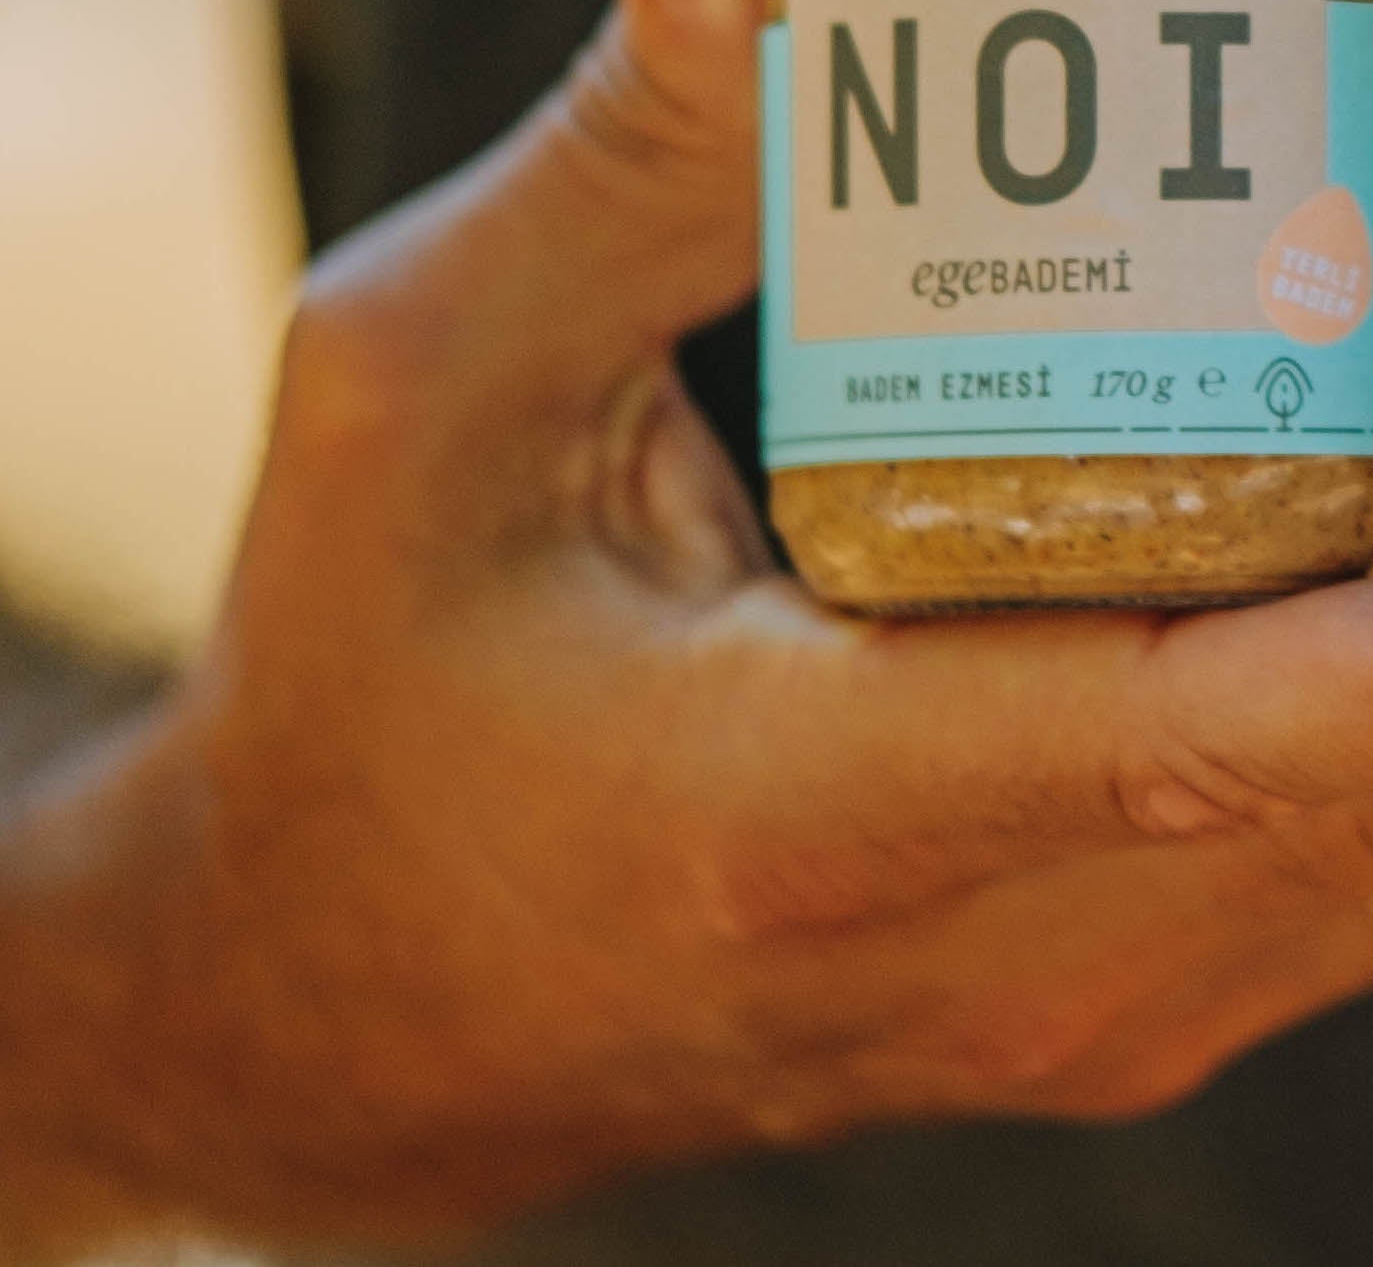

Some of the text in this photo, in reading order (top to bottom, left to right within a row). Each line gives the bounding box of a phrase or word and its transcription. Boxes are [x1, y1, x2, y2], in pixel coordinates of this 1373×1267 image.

[828, 9, 1251, 210] NOI
[1271, 274, 1354, 319] BADEM
[846, 373, 921, 404] BADEM
[940, 363, 1052, 400] EZMESİ
